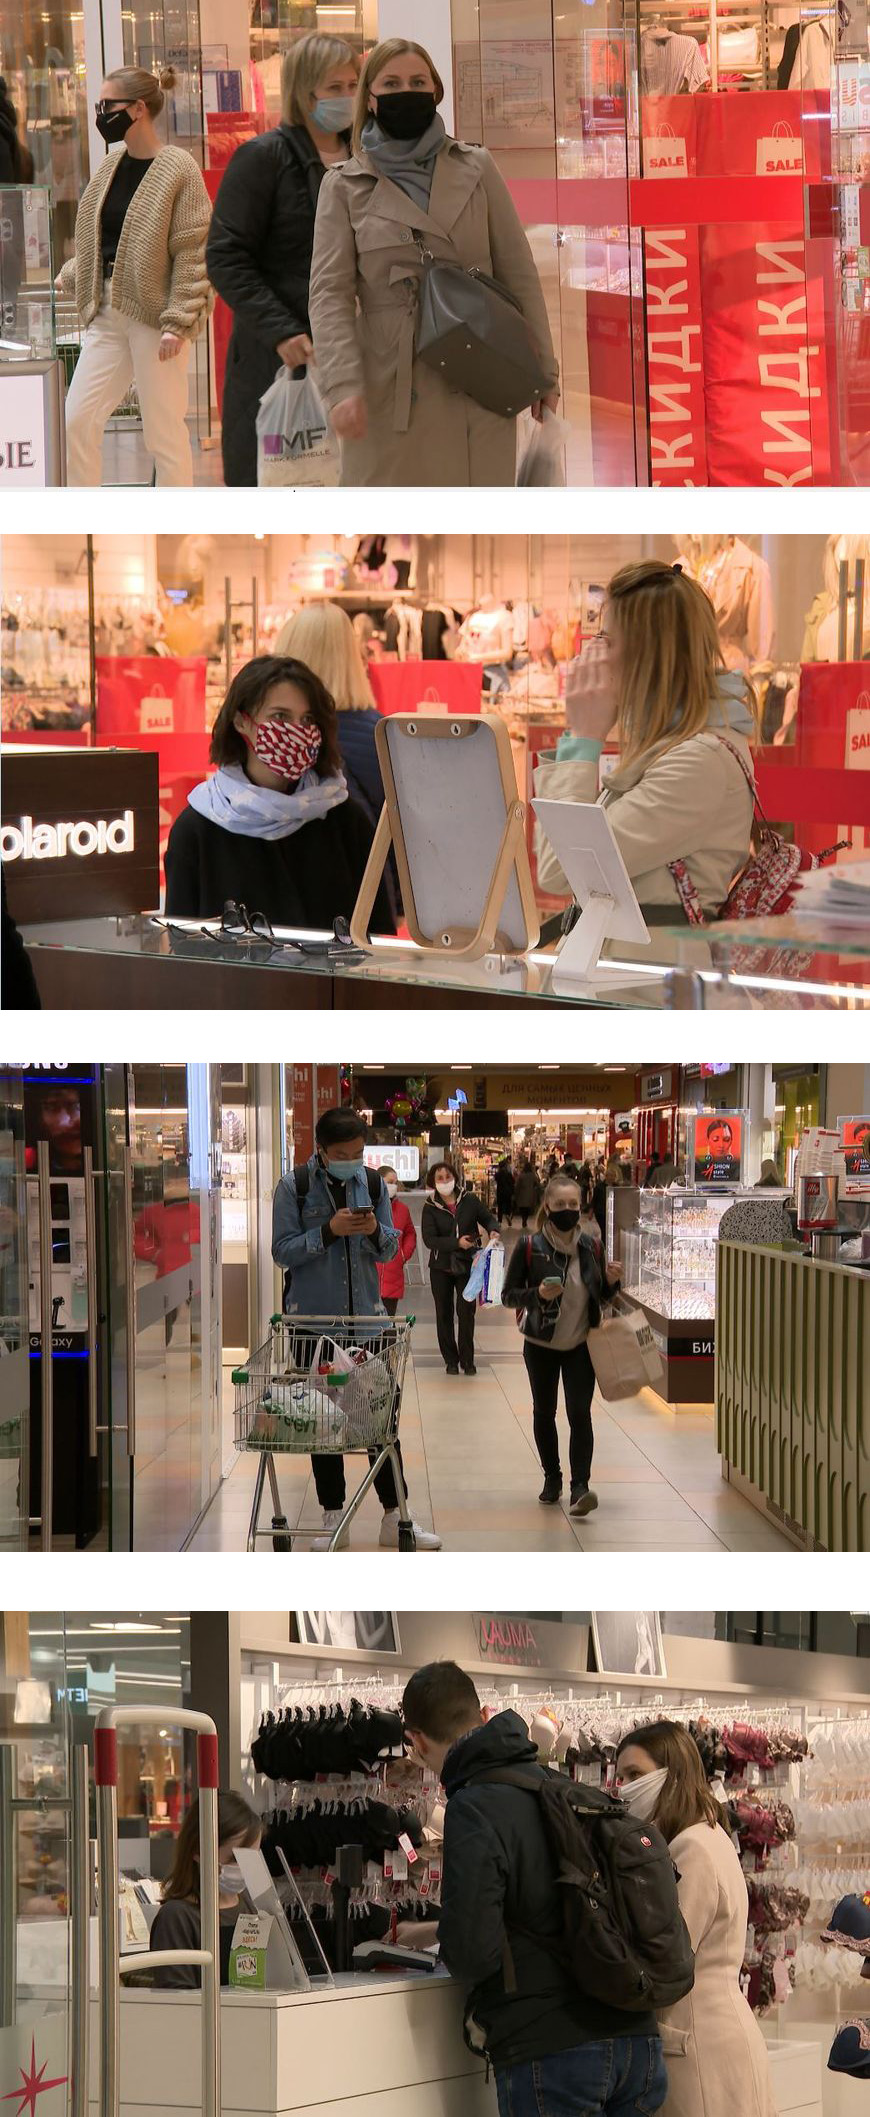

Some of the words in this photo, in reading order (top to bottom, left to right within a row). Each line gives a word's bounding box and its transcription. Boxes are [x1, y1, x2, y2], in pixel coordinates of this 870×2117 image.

[649, 156, 685, 168] SALE
[765, 158, 804, 172] SALE
[645, 229, 703, 487] КИДКИ
[282, 427, 326, 450] MF
[286, 449, 330, 460] FORMELLE
[147, 717, 171, 728] SALE
[30, 1336, 73, 1349] Gaxy
[692, 1342, 715, 1354] БИ
